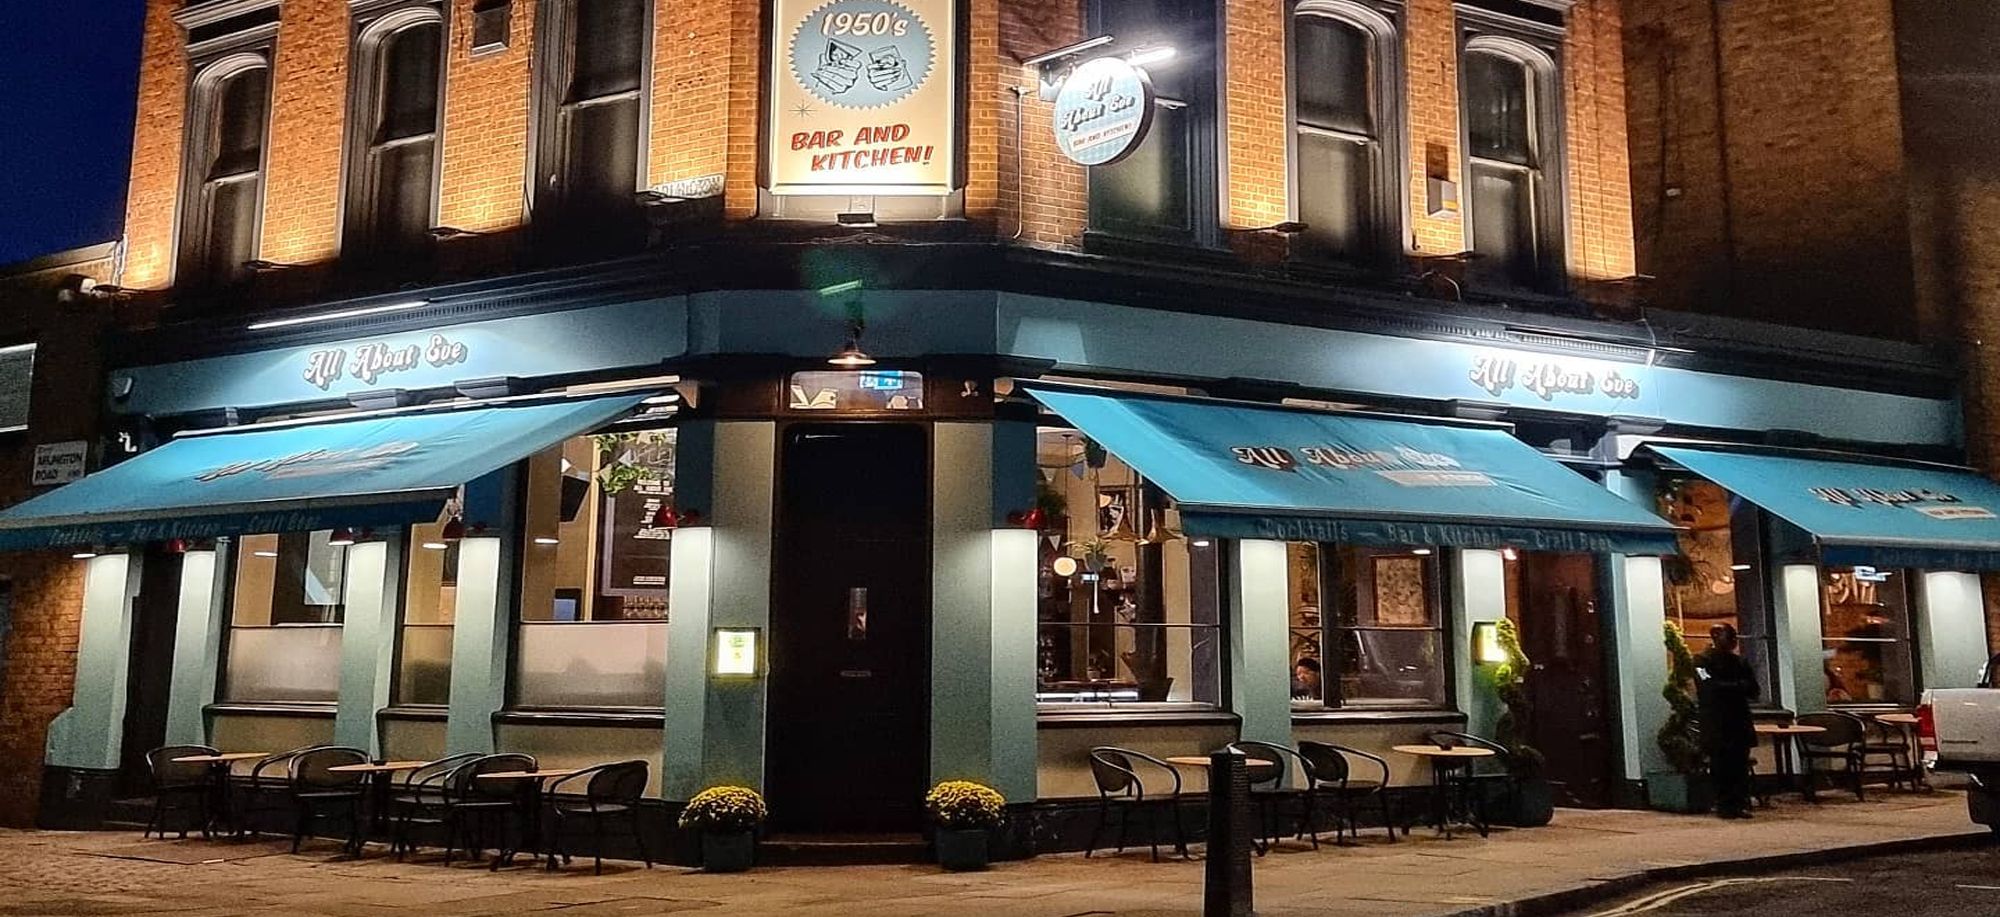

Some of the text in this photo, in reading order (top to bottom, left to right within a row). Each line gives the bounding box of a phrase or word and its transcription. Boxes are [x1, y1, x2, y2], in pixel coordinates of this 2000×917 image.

[820, 12, 909, 37] 1950's
[1085, 74, 1114, 101] All
[791, 123, 910, 151] BAR AND
[811, 145, 934, 172] KITCHEN!
[303, 334, 468, 391] All About Eve
[1469, 354, 1640, 401] All About Eve
[1230, 446, 1296, 473] All
[1259, 518, 1349, 540] Cocktails
[1386, 523, 1414, 543] Bar
[1423, 523, 1433, 543] &
[1439, 525, 1498, 545] Kitchen
